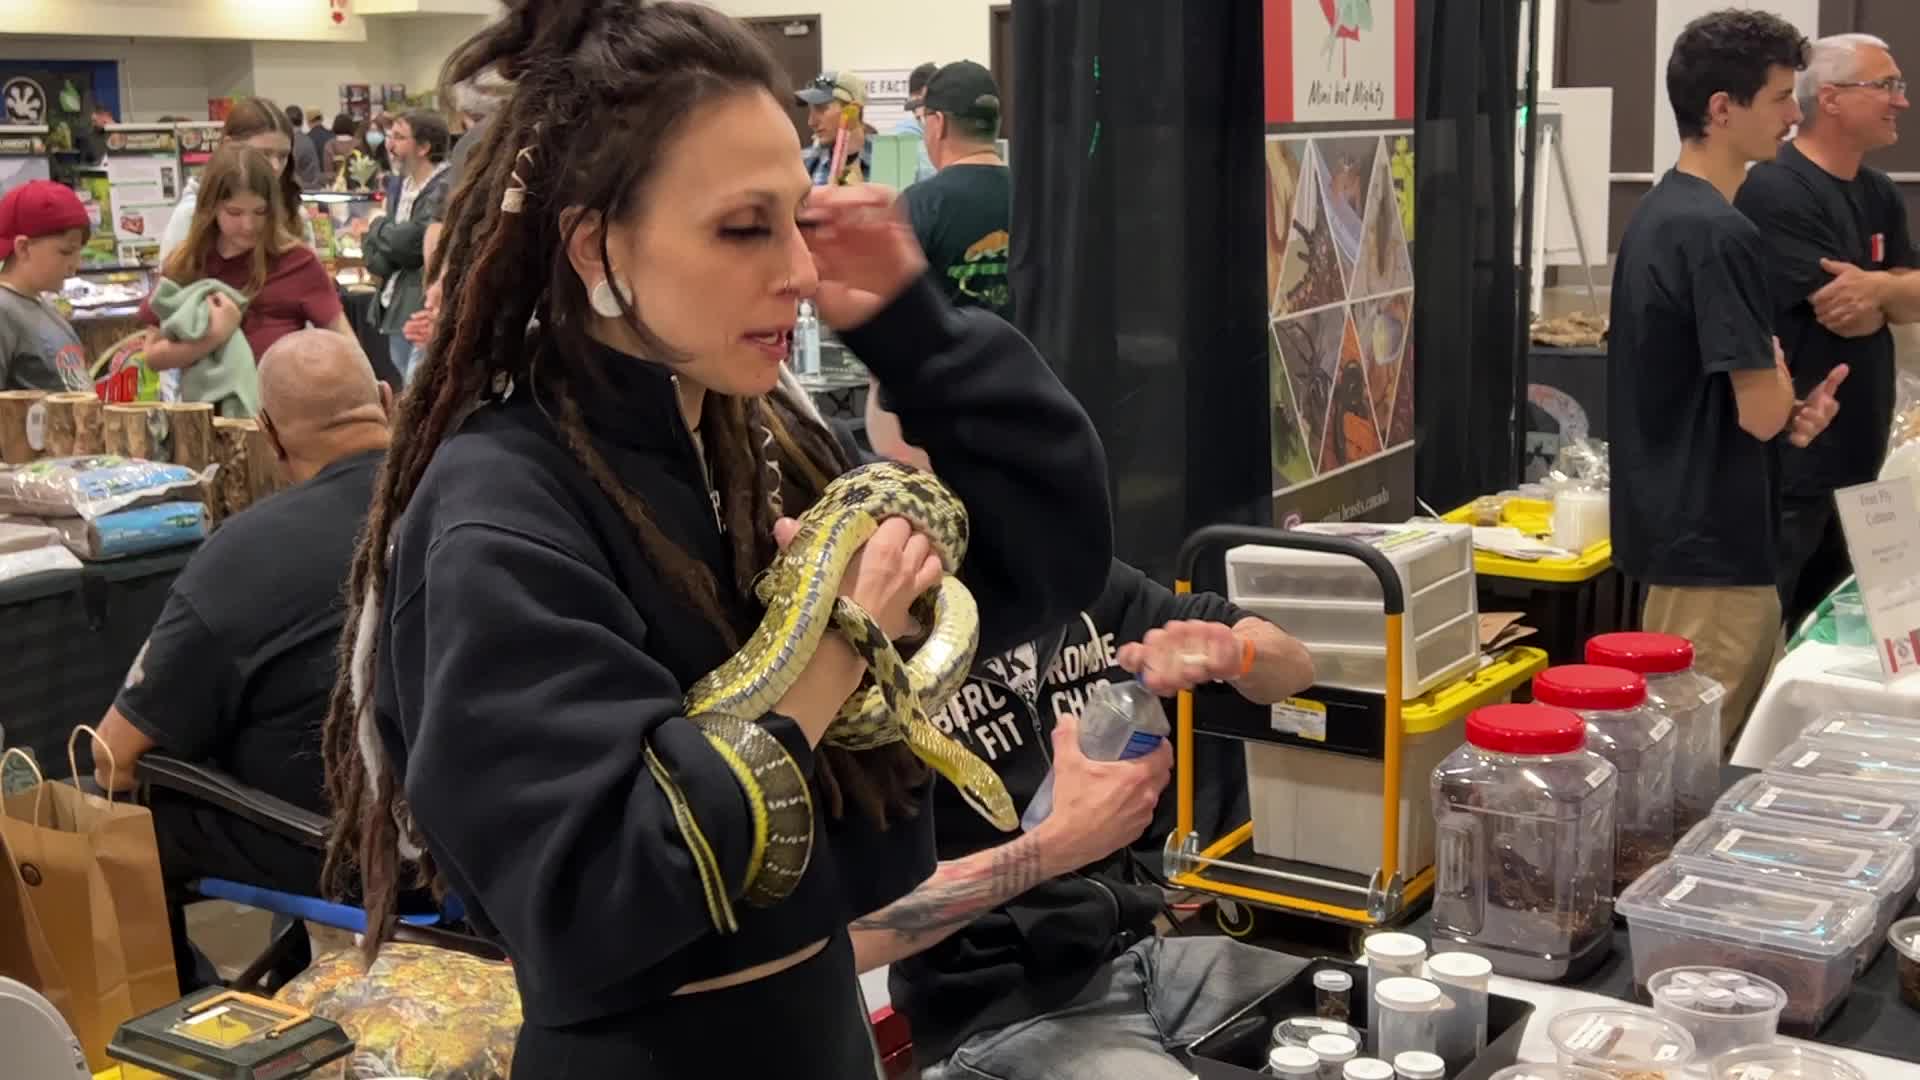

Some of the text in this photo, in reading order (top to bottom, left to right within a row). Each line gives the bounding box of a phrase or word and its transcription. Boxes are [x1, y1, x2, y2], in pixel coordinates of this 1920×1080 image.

[1307, 79, 1385, 112] Mini but Mighty
[975, 711, 1023, 760] FIT
